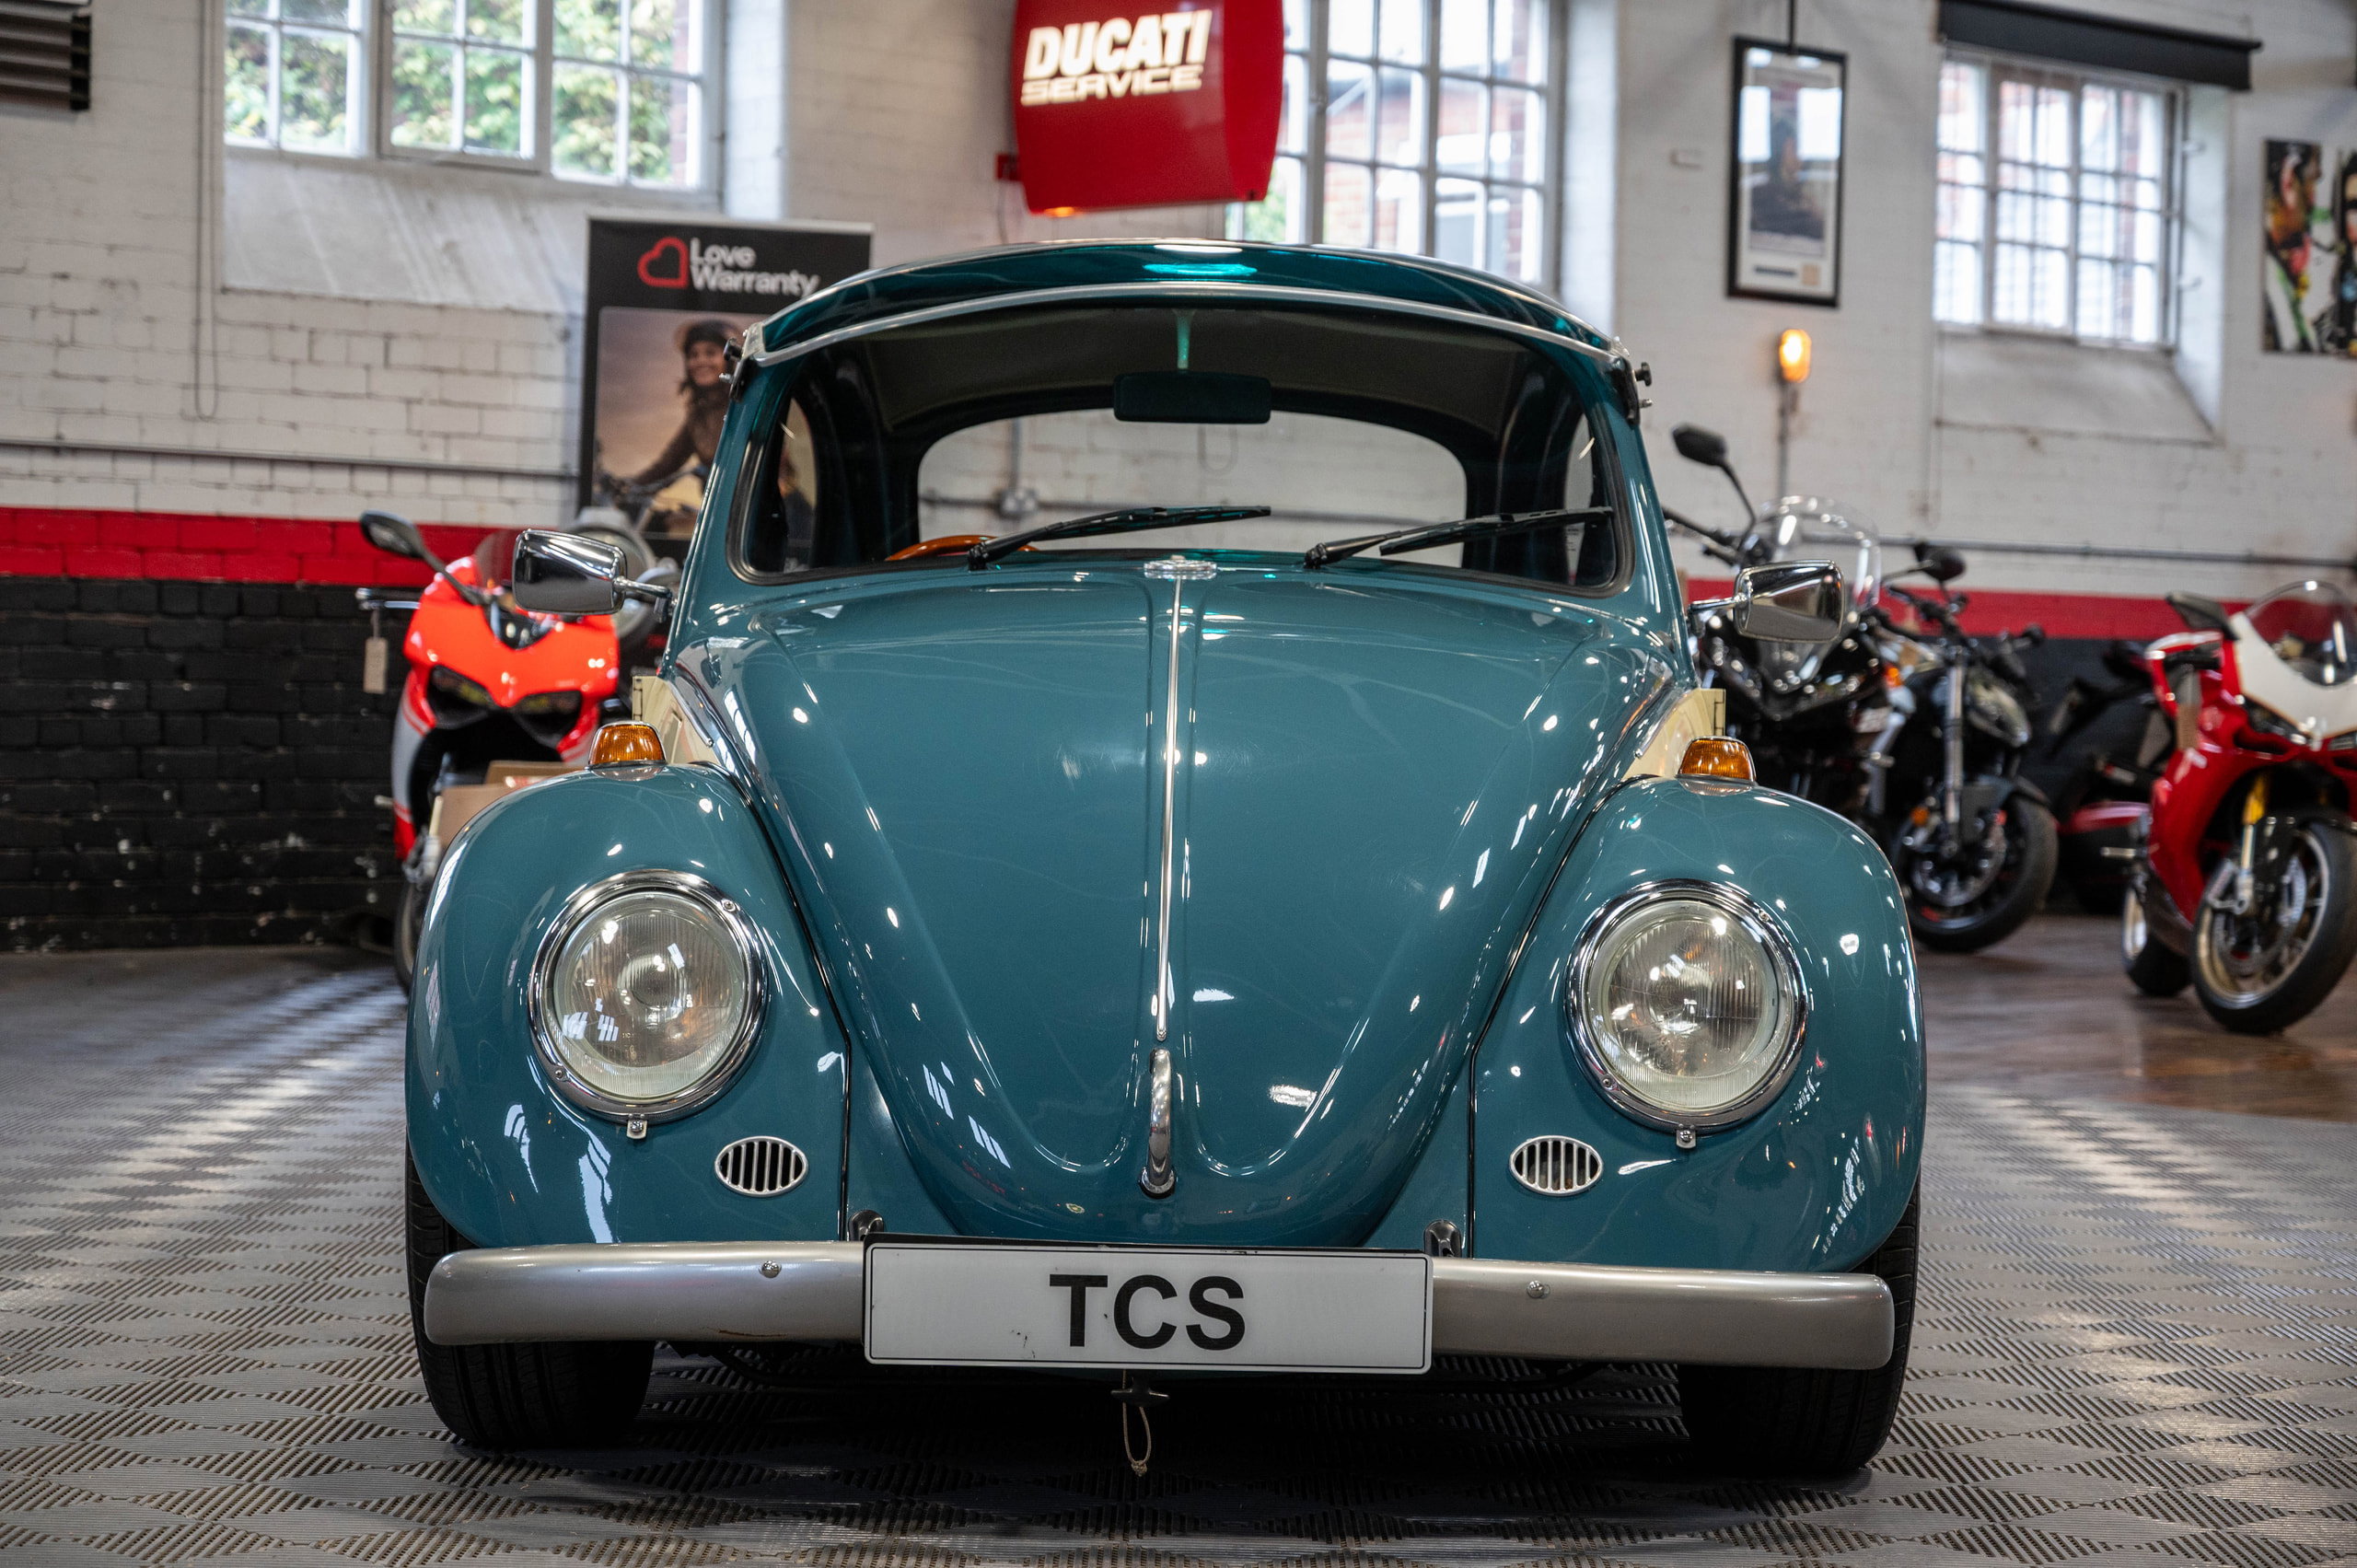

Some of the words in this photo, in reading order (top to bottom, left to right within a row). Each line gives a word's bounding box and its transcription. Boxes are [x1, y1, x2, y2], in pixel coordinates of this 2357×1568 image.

[1023, 10, 1213, 79] DUCATI
[1021, 65, 1203, 106] SERVICE
[691, 238, 756, 268] Love
[691, 264, 819, 296] Warranty
[1050, 1274, 1246, 1351] TCS
